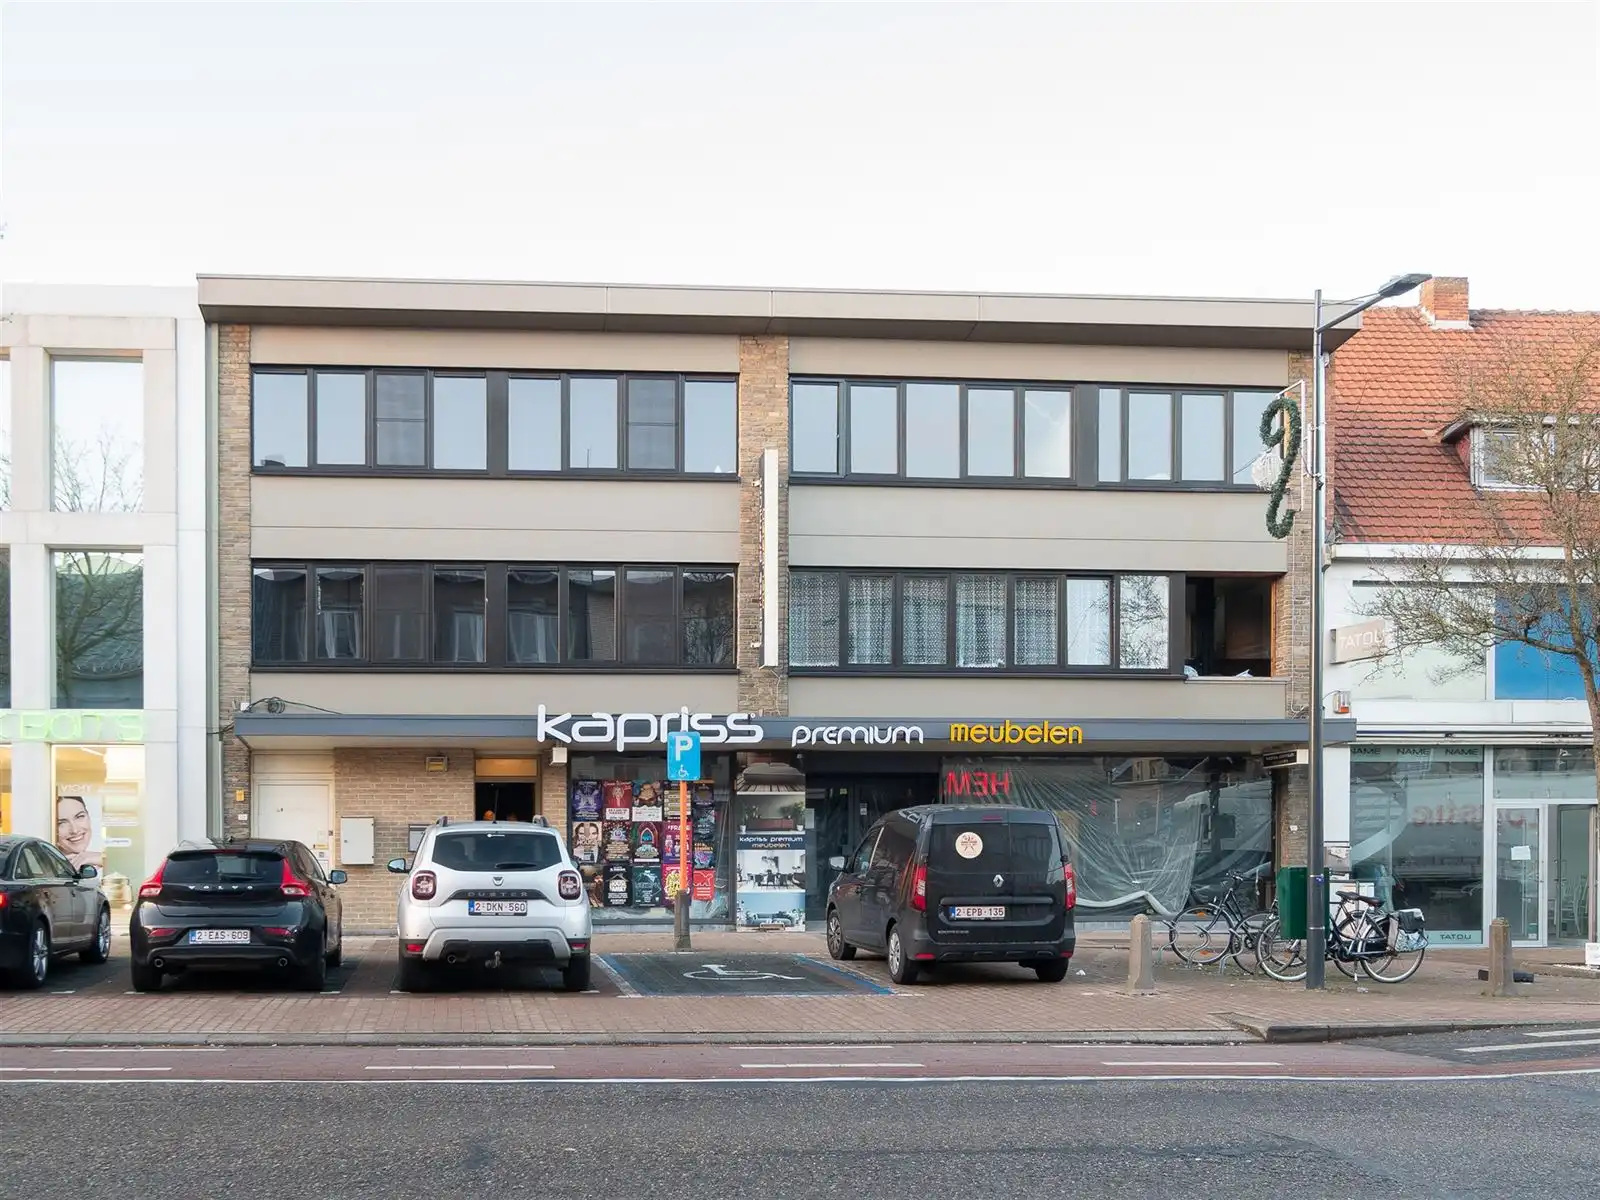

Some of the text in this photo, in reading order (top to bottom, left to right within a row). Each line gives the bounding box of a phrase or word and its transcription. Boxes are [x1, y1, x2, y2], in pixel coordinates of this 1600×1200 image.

[1339, 629, 1385, 650] TATOU
[537, 704, 1083, 752] kapriss premium meubelen
[675, 735, 693, 761] P
[1396, 747, 1430, 756] NAME
[1445, 747, 1479, 756] NAME
